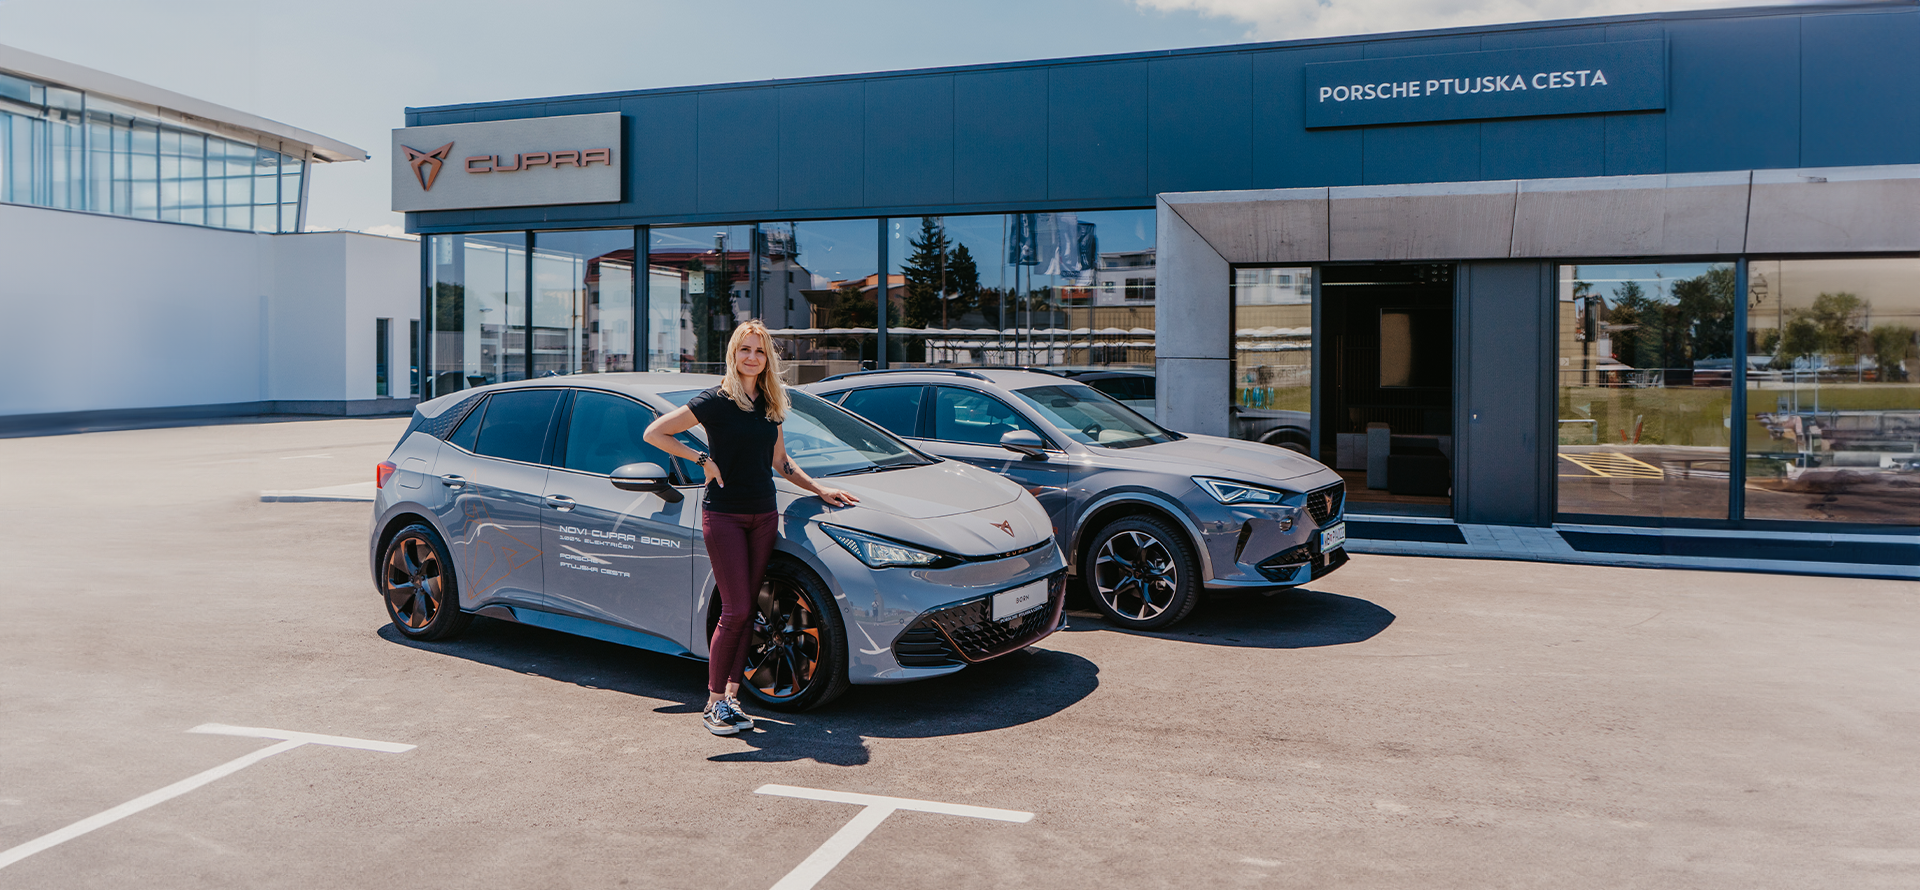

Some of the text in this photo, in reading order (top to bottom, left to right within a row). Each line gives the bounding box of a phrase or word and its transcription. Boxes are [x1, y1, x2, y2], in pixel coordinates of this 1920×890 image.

[1319, 69, 1608, 103] PORSCHE PTUJSKA CESTA
[464, 147, 611, 174] CUPRA
[559, 525, 680, 549] NOVI CUPRA BORN
[584, 538, 634, 550] ELEKTRIČEN
[559, 553, 599, 564] PORSCHE
[559, 561, 631, 578] PTUJSKA CESTA
[1016, 594, 1030, 604] BORN
